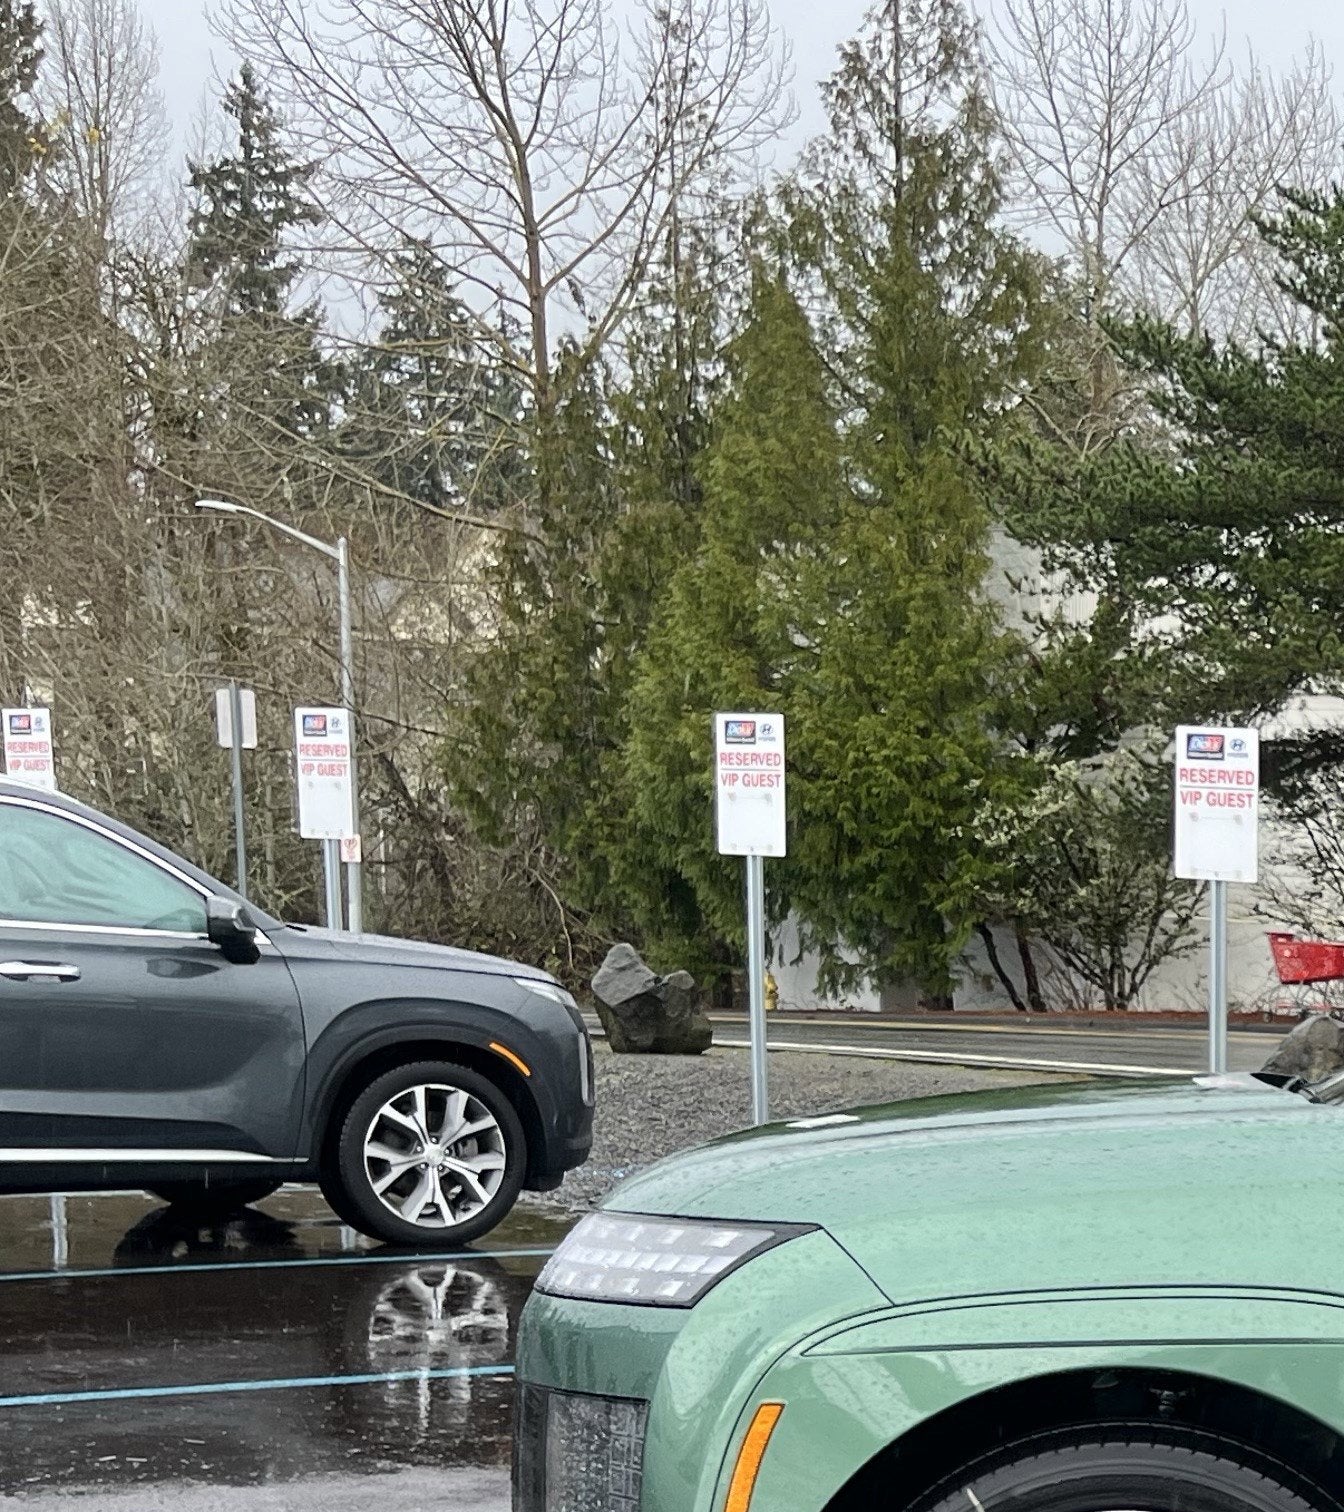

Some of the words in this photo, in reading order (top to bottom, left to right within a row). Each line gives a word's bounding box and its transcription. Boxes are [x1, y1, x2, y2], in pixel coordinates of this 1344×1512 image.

[300, 743, 348, 757] RESERVED
[720, 752, 781, 767] RESERVED
[301, 763, 315, 776] VIP
[317, 763, 348, 777] GUEST
[1179, 768, 1255, 786] RESERVED
[721, 773, 739, 787] VIP
[742, 773, 781, 788] GUEST
[1180, 791, 1202, 805] VIP
[1206, 791, 1254, 809] GUEST
